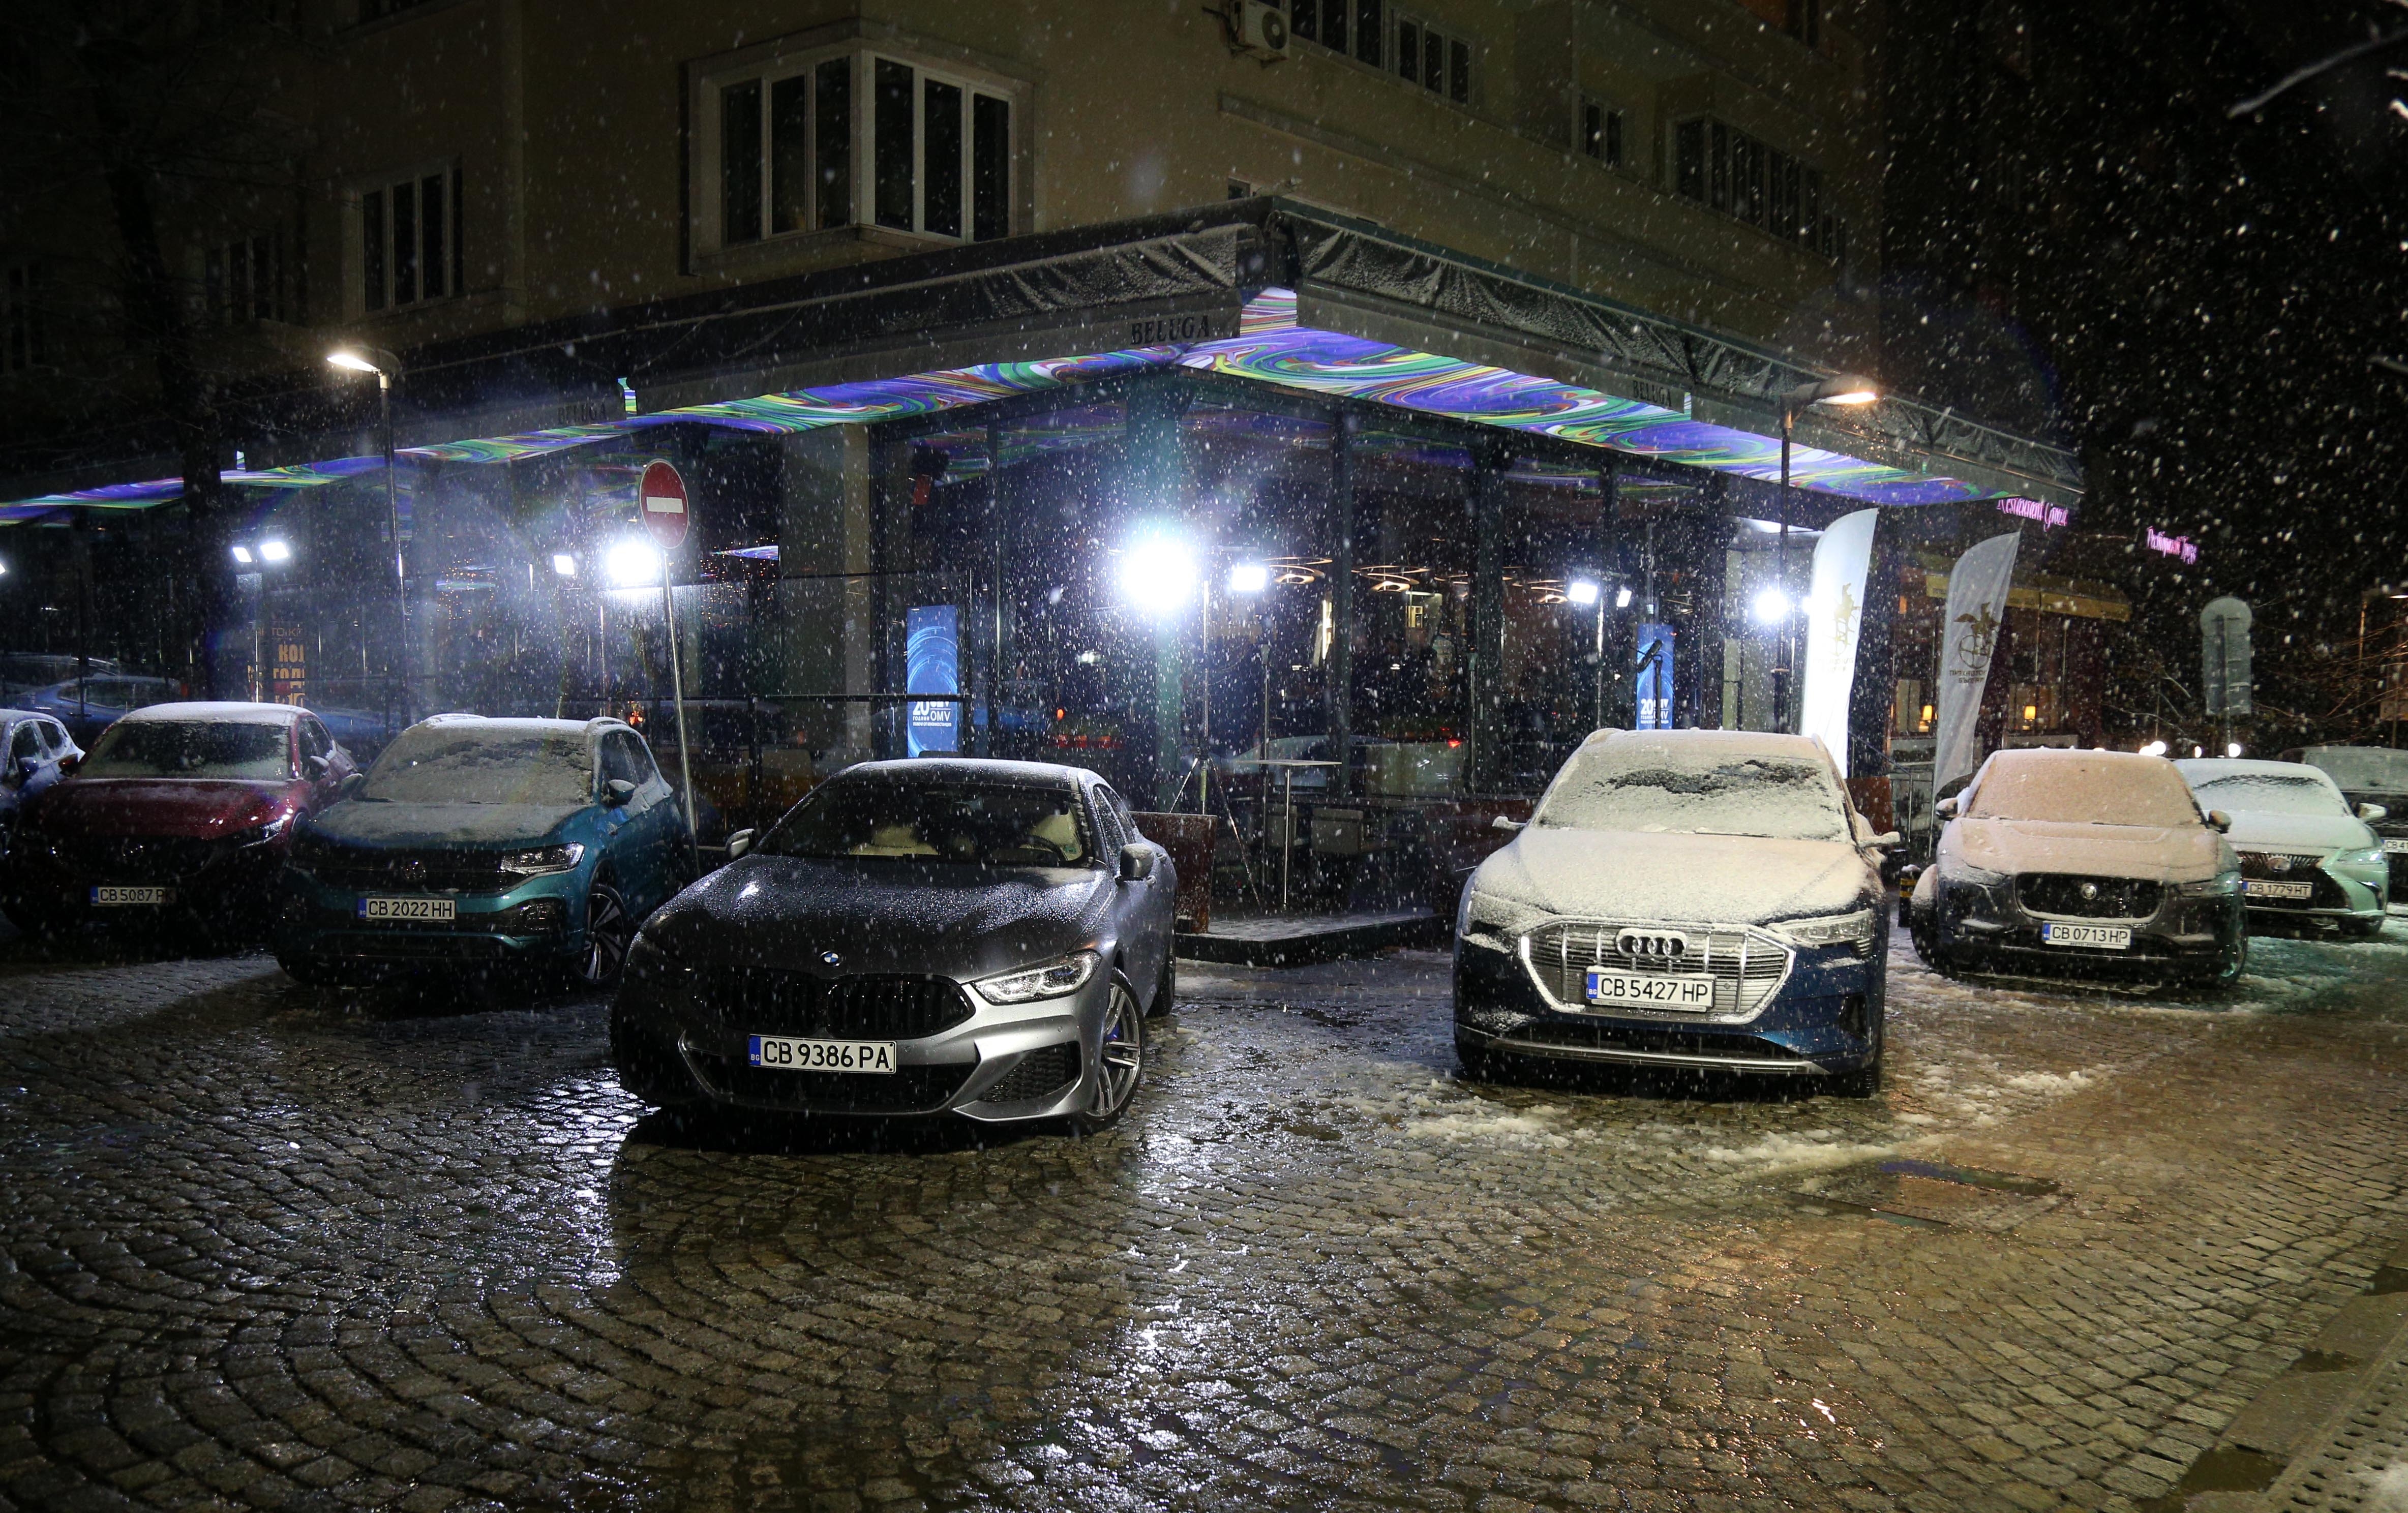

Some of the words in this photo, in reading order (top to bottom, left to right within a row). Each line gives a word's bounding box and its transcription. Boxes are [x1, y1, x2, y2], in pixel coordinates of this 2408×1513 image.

[1130, 315, 1210, 345] BELUGA
[1640, 698, 1653, 715] 20
[930, 711, 950, 721] OMV
[100, 889, 117, 901] CB
[120, 889, 153, 901] 5087
[2249, 884, 2264, 893] CB
[2267, 885, 2292, 895] 1779
[2295, 886, 2309, 896] HT
[369, 901, 388, 916] CB
[391, 901, 429, 917] 2022
[432, 902, 452, 917] HH
[2052, 927, 2070, 940] CB
[2073, 928, 2106, 942] 0713
[2110, 930, 2128, 943] HP
[1601, 978, 1626, 997] CB
[1630, 980, 1678, 1001] 5427
[1682, 983, 1708, 1002] HP
[764, 1041, 793, 1064] CB
[797, 1043, 854, 1068] 9386
[859, 1046, 890, 1069] PA
